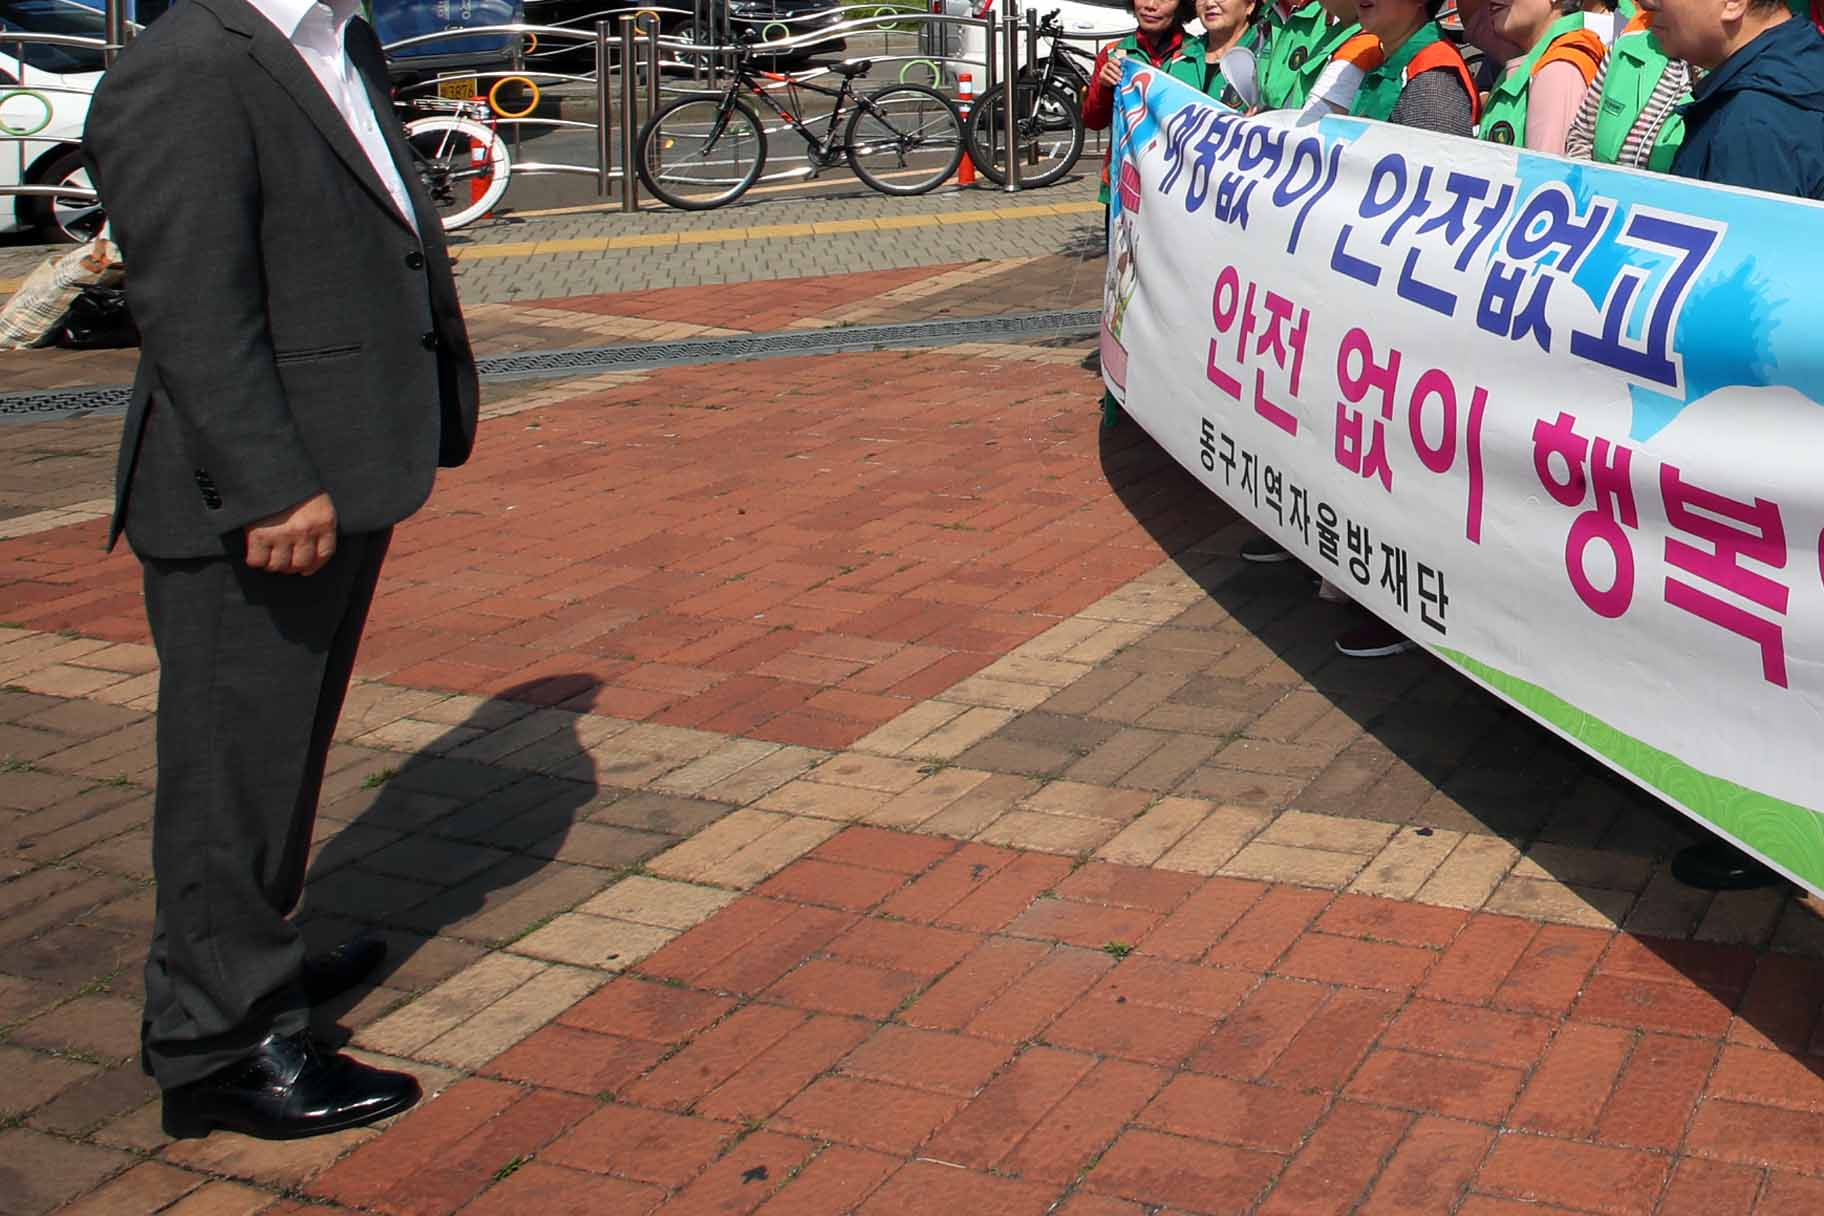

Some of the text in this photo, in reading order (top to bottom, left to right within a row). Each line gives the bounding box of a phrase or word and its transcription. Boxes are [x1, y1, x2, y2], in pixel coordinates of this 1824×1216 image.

[1158, 104, 1720, 388] 예방없이 안전없고
[1198, 416, 1450, 636] 동구지역자율방재단
[1205, 264, 1309, 437] 안전
[1334, 327, 1490, 545] 없이
